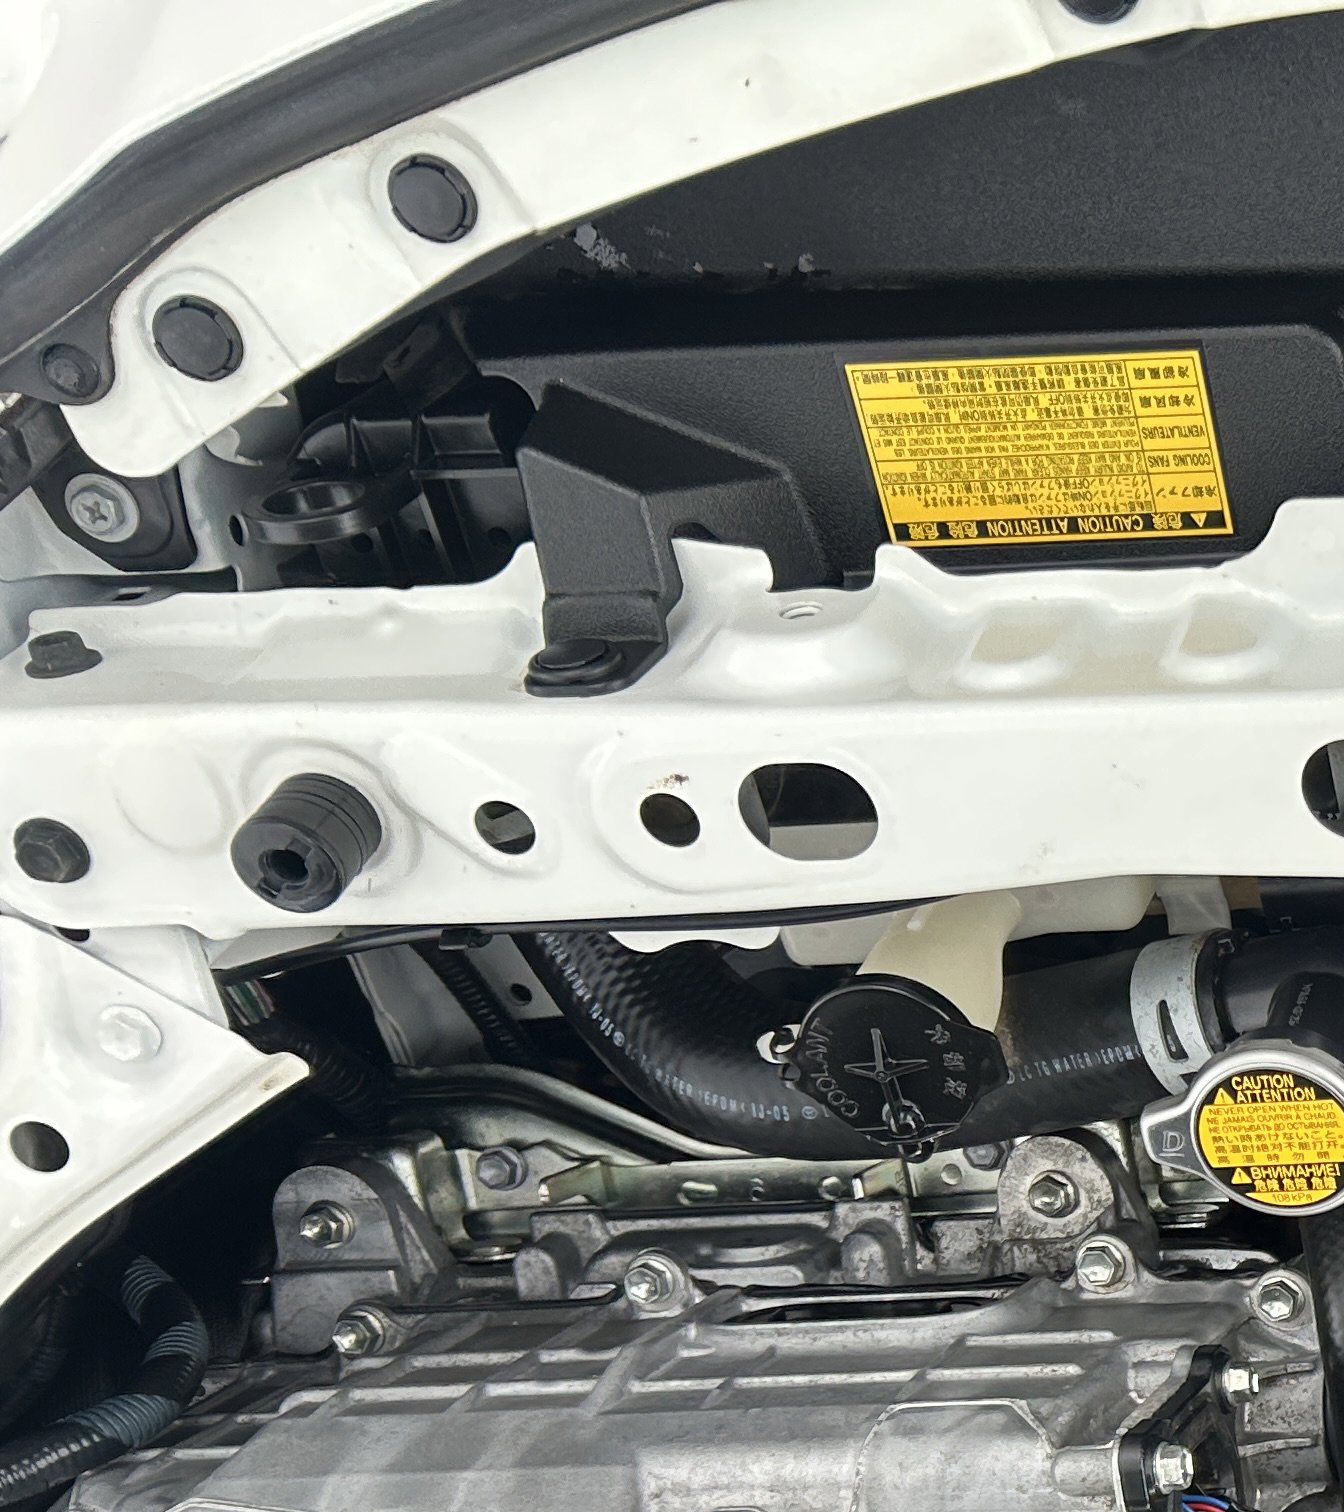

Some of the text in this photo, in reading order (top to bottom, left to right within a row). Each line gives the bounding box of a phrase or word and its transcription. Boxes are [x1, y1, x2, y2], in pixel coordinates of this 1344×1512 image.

[1142, 425, 1204, 439] VENTILATEURS
[1147, 453, 1210, 468] COOLING FANS
[986, 518, 1068, 536] ATTENTION
[1077, 515, 1143, 533] CAUTION
[806, 1018, 859, 1117] COOLANT
[1052, 1052, 1093, 1073] WATER
[1232, 1074, 1294, 1090] CAUTION
[1236, 1087, 1315, 1104] ATTENTION
[1209, 1107, 1244, 1116] NEVER
[1247, 1105, 1276, 1113] OPEN
[1280, 1104, 1310, 1112] WHEN
[1207, 1117, 1219, 1125] NE
[1222, 1115, 1255, 1123] JAMAIS
[1257, 1113, 1292, 1122] OUVRIR
[1251, 1164, 1340, 1179] ВНИМАНИЕ!
